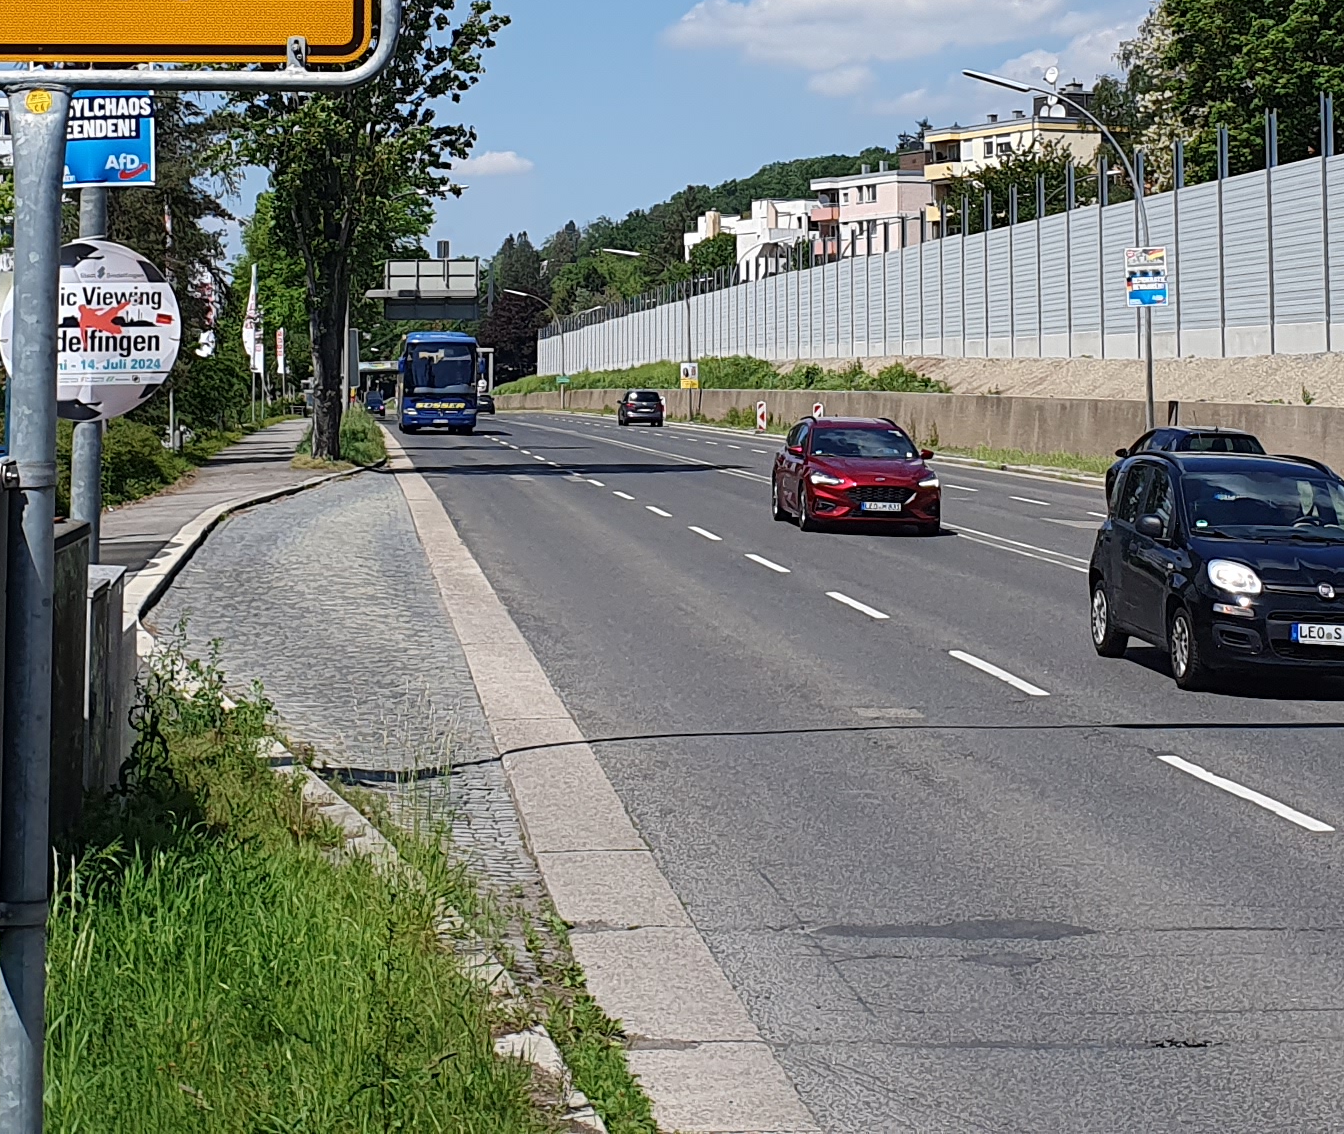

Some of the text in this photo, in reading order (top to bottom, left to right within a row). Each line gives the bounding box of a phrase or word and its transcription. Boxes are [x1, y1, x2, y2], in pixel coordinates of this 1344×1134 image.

[66, 119, 136, 139] EENDEN!
[104, 153, 140, 170] AfD
[60, 286, 162, 310] ic Viewing
[57, 330, 160, 357] delfingen
[103, 358, 127, 370] Juli
[130, 358, 161, 370] 2024
[1300, 626, 1325, 639] LEO
[1334, 627, 1342, 640] S
